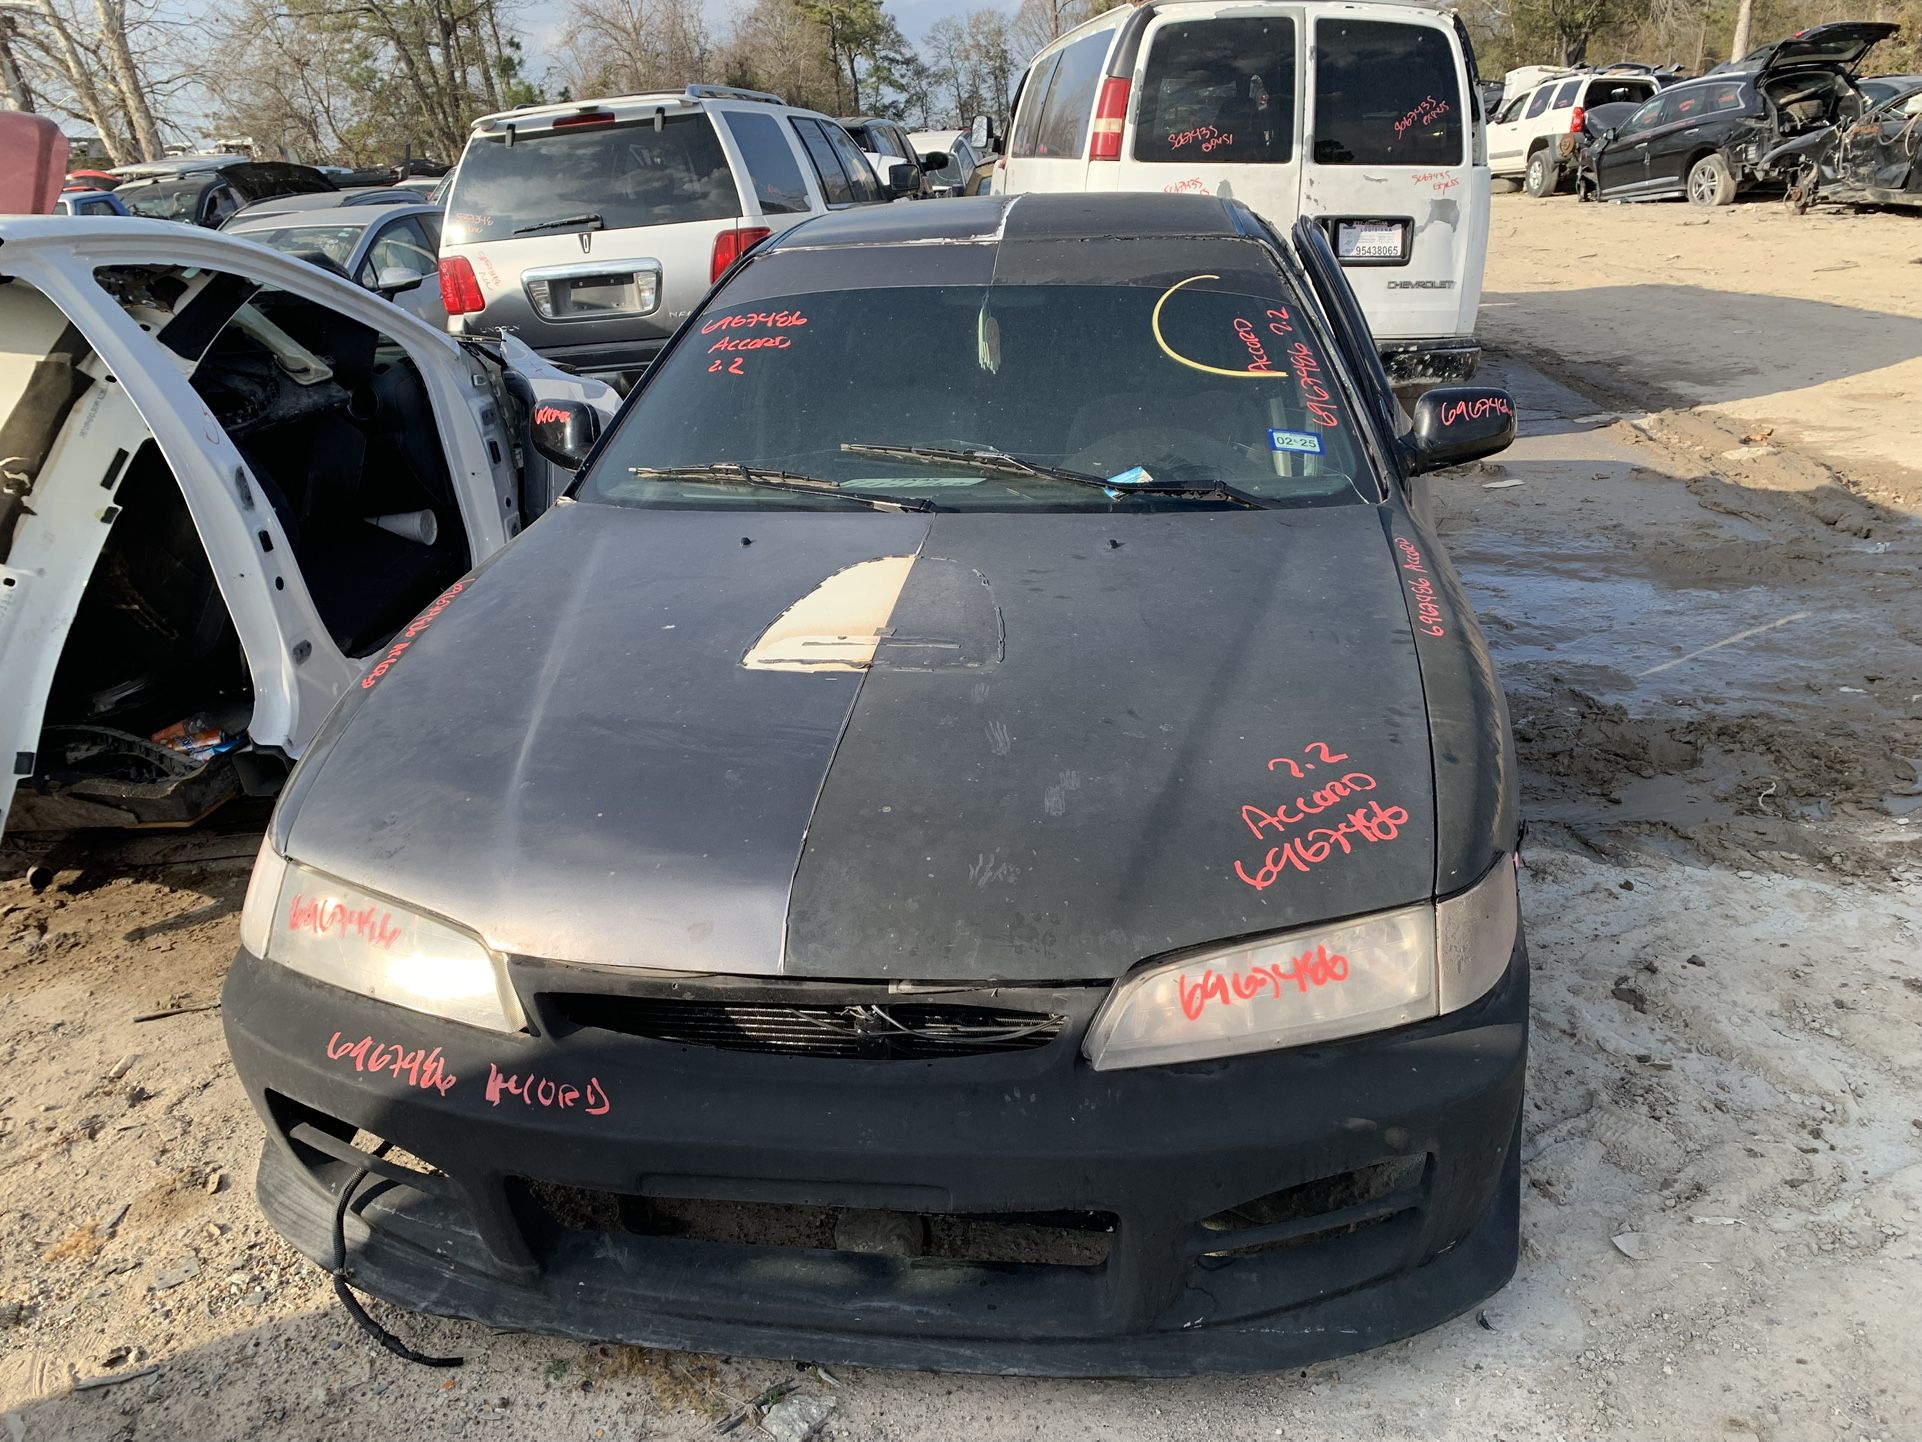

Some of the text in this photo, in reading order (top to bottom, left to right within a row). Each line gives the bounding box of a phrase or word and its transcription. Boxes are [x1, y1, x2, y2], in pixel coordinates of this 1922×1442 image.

[1355, 245, 1399, 256] 95438065
[1387, 280, 1456, 290] CHEVROLET
[1266, 305, 1293, 336] 2.2
[707, 356, 745, 375] 2.2
[1267, 741, 1349, 779] 2.2
[1233, 800, 1409, 891] 6967486
